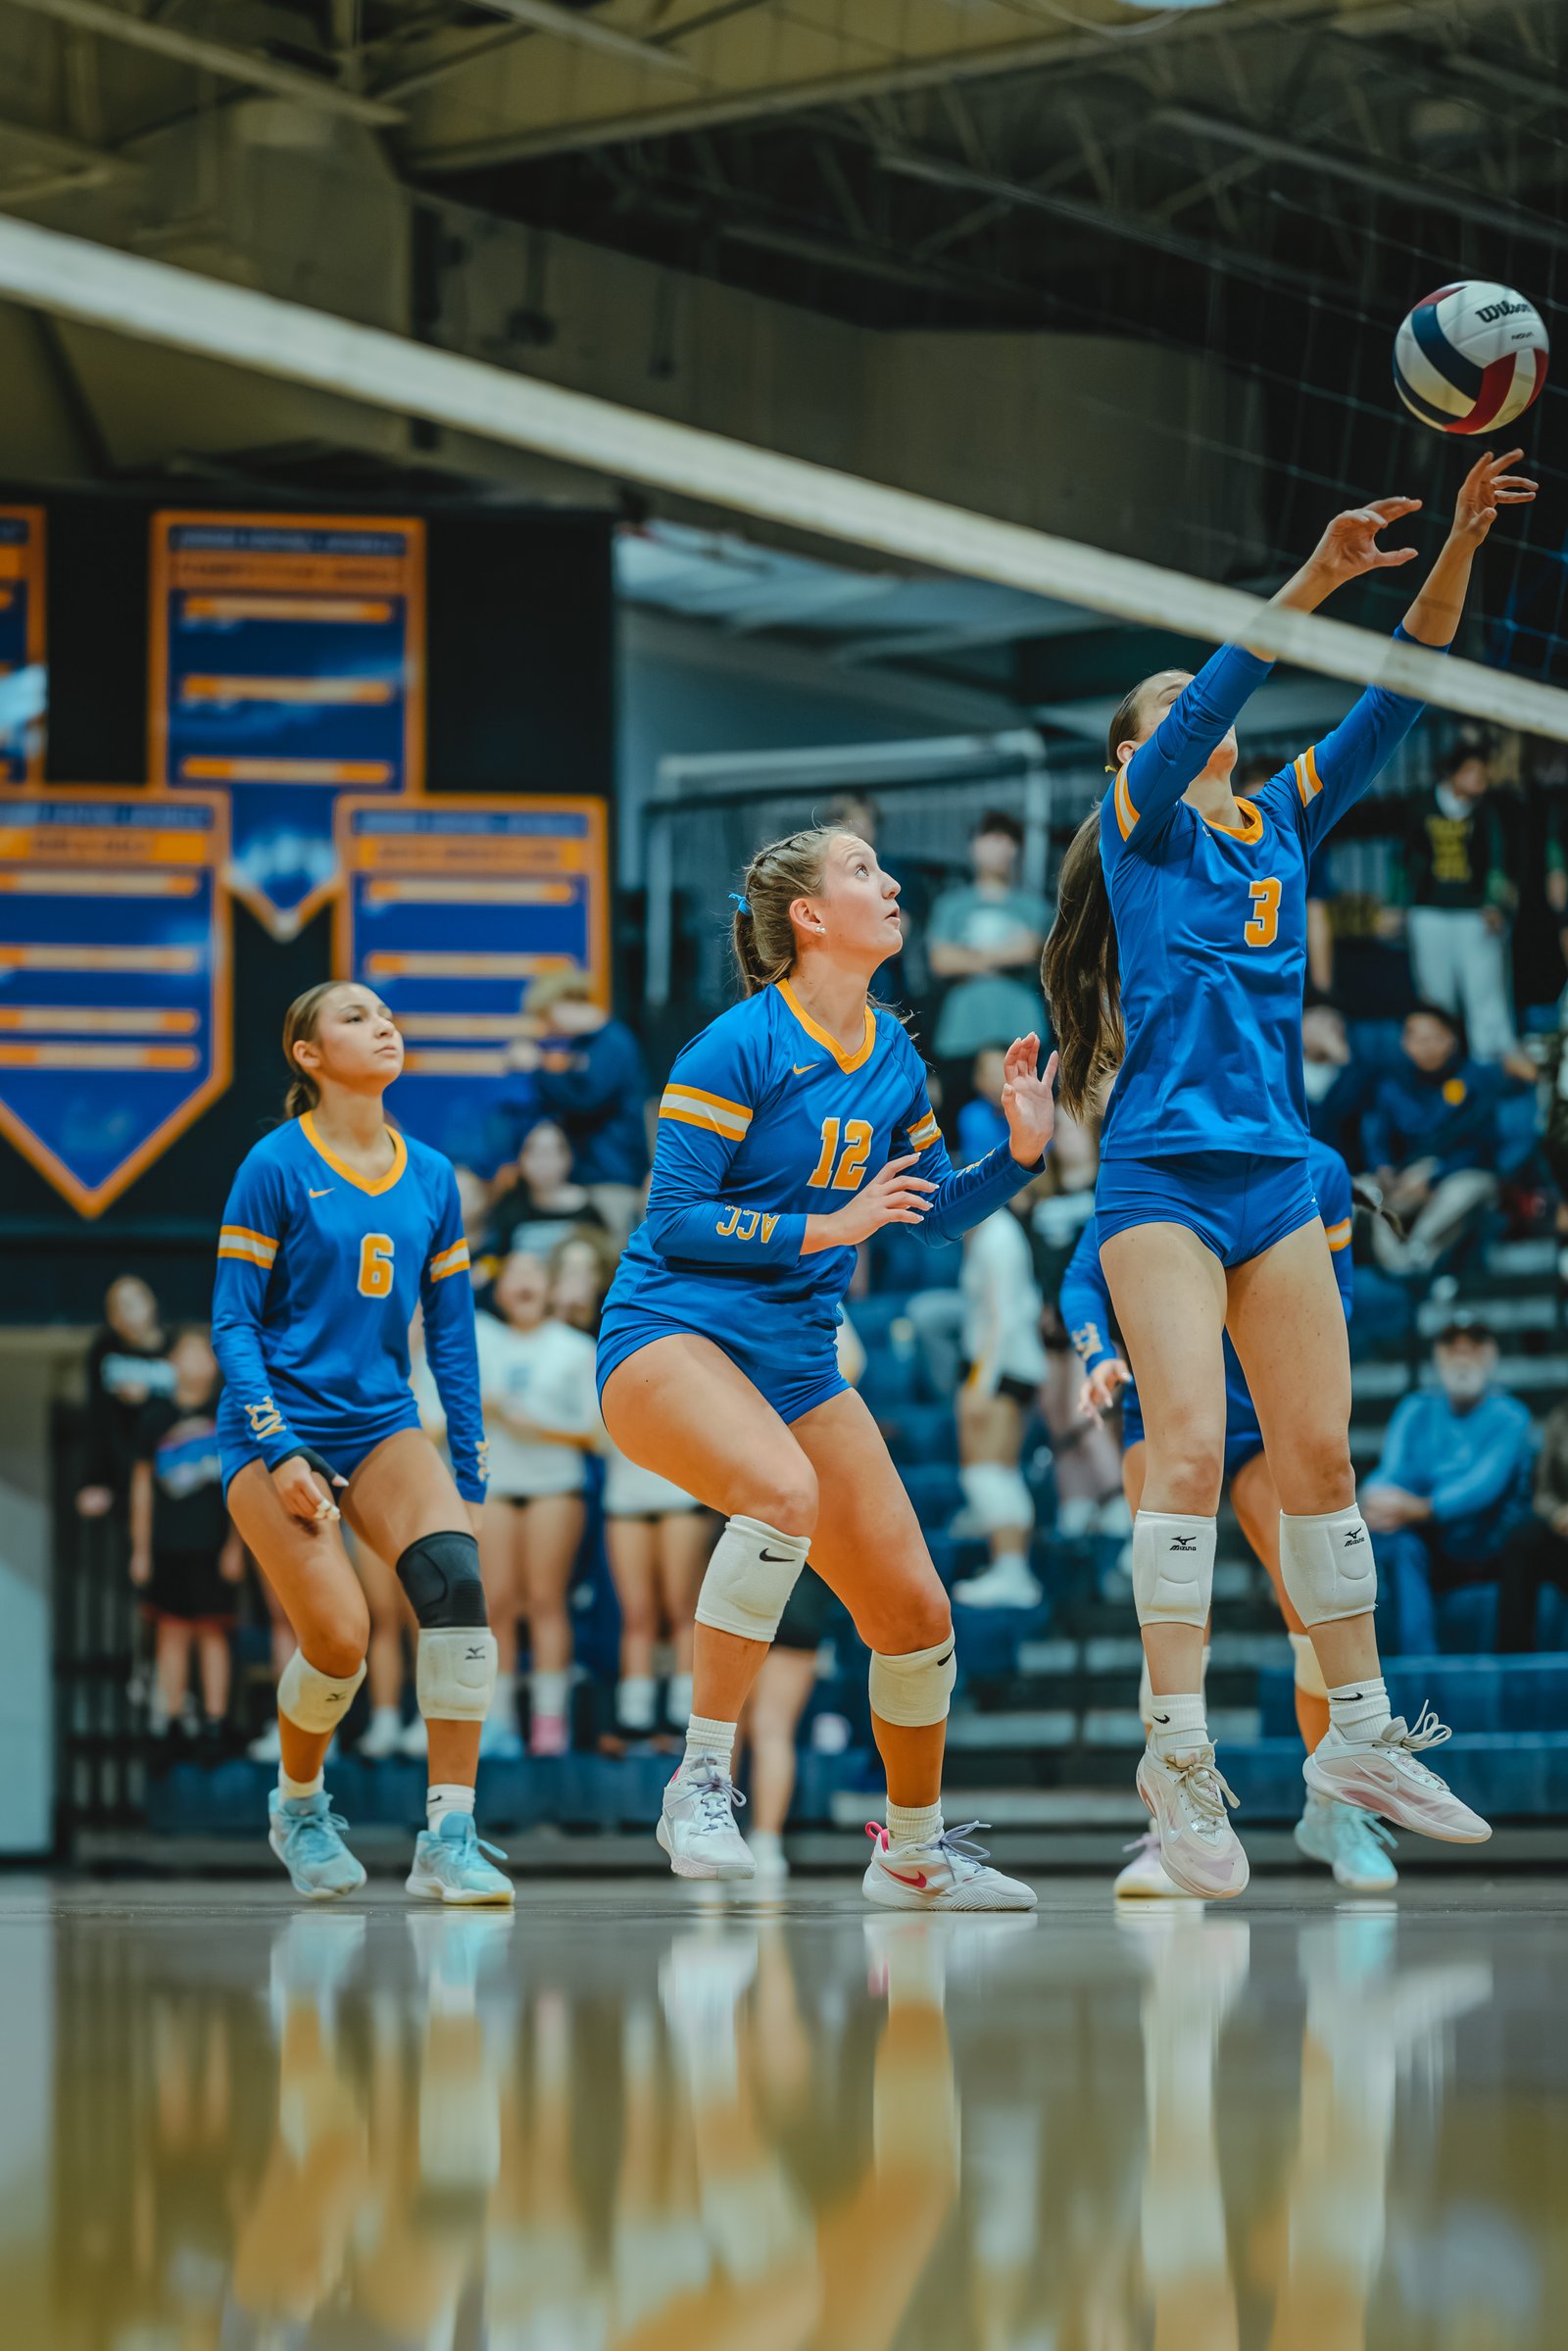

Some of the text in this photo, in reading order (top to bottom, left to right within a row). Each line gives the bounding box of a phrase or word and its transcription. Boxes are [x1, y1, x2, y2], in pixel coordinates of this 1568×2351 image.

[1475, 300, 1532, 322] Wilson
[1244, 876, 1283, 948] 3
[806, 1117, 874, 1191] 12
[715, 1205, 781, 1244] ACC
[357, 1232, 395, 1298] 6
